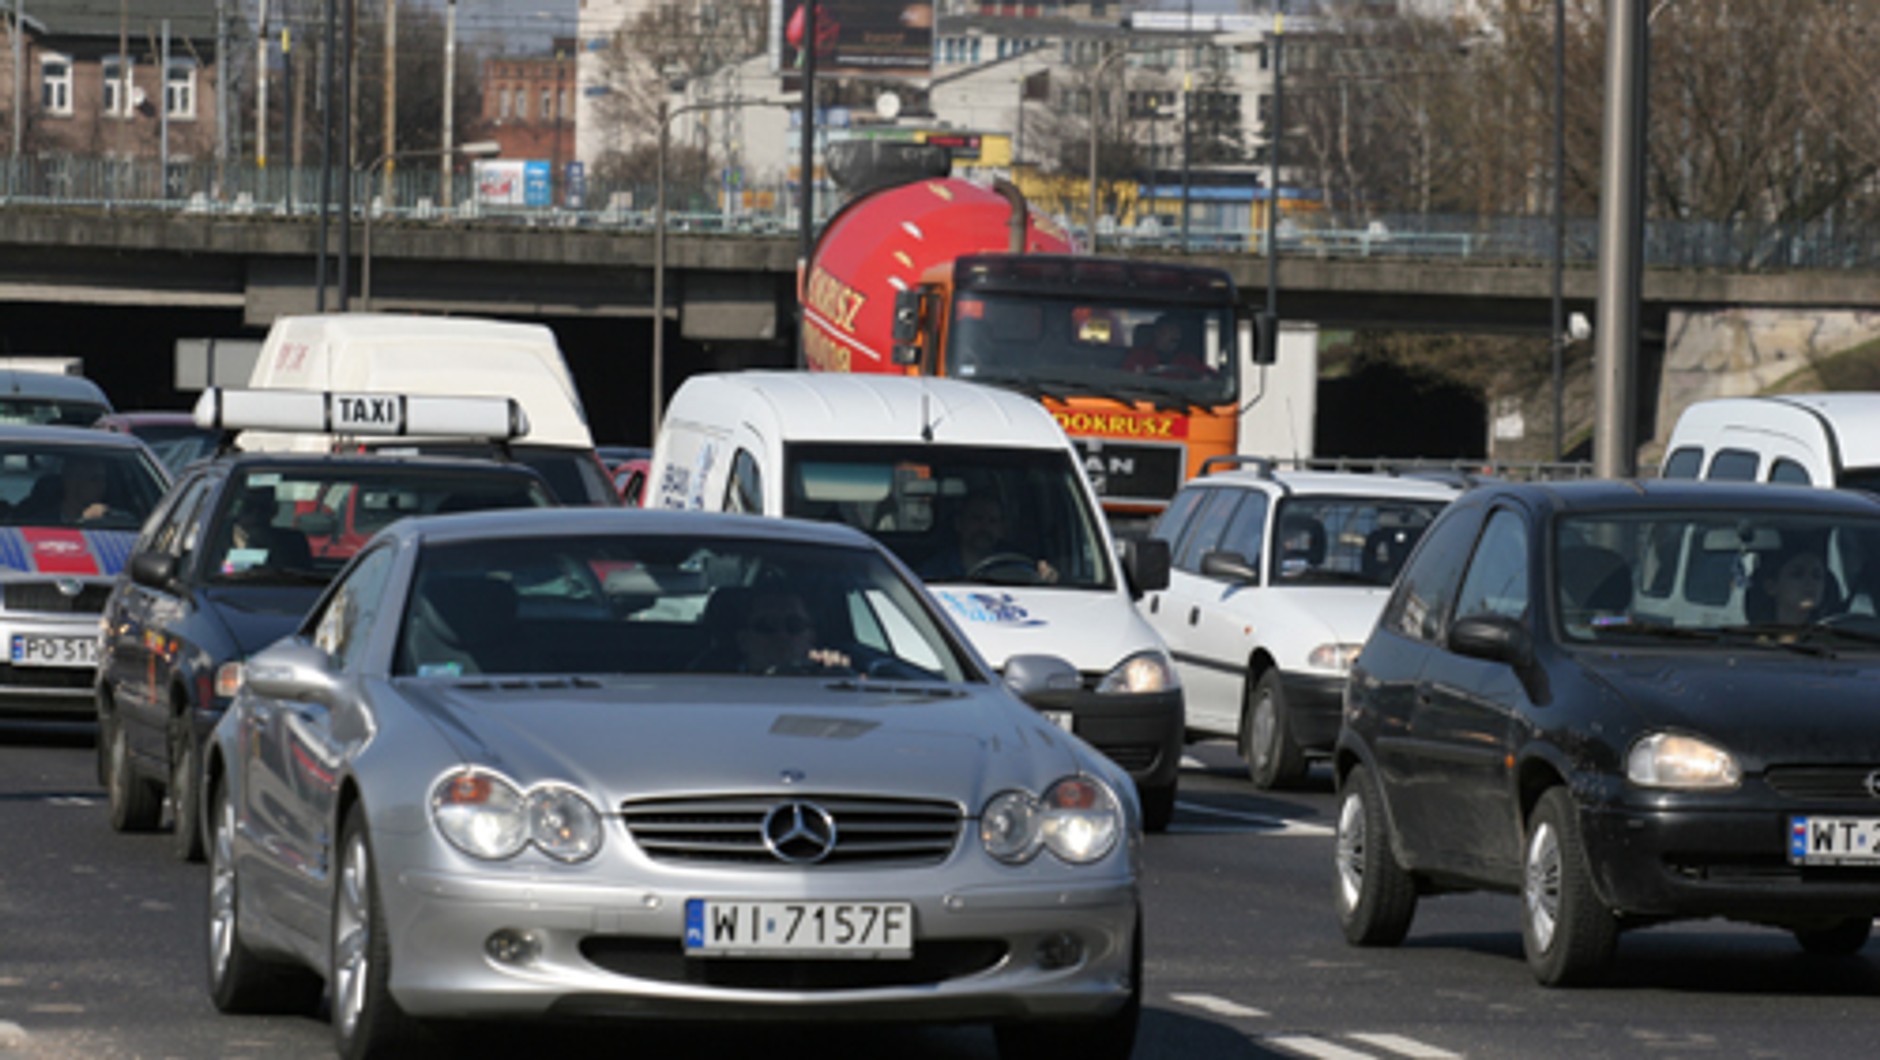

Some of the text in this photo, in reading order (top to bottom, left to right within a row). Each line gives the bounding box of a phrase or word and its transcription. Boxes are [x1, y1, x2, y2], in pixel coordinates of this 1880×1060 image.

[338, 398, 395, 423] TAXI
[26, 638, 58, 660] PO
[1812, 822, 1859, 852] WT
[713, 906, 905, 944] WI 7157F
